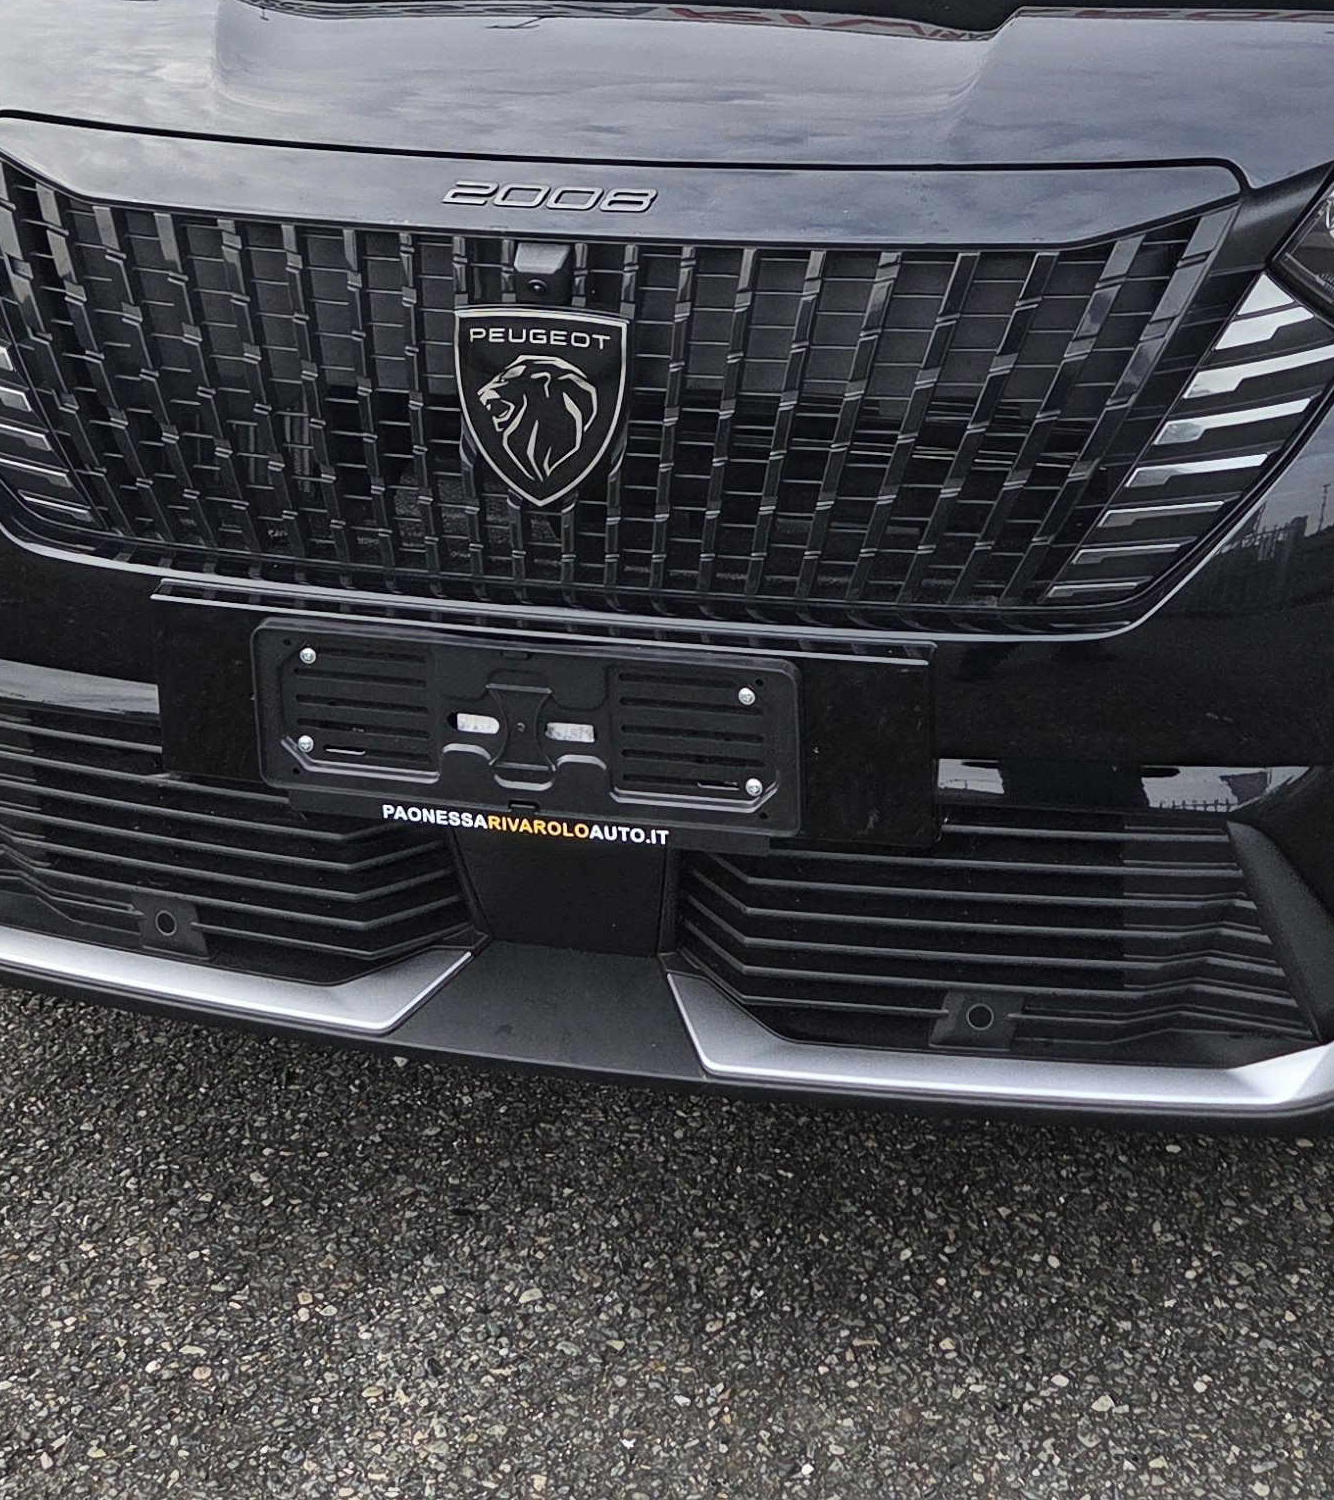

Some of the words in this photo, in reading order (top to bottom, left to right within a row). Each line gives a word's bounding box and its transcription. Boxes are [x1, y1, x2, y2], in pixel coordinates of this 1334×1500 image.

[442, 180, 659, 213] 2008
[469, 326, 612, 351] PEUGEOT
[382, 803, 670, 846] PAONESSARIVAROLOAUTO.IT
